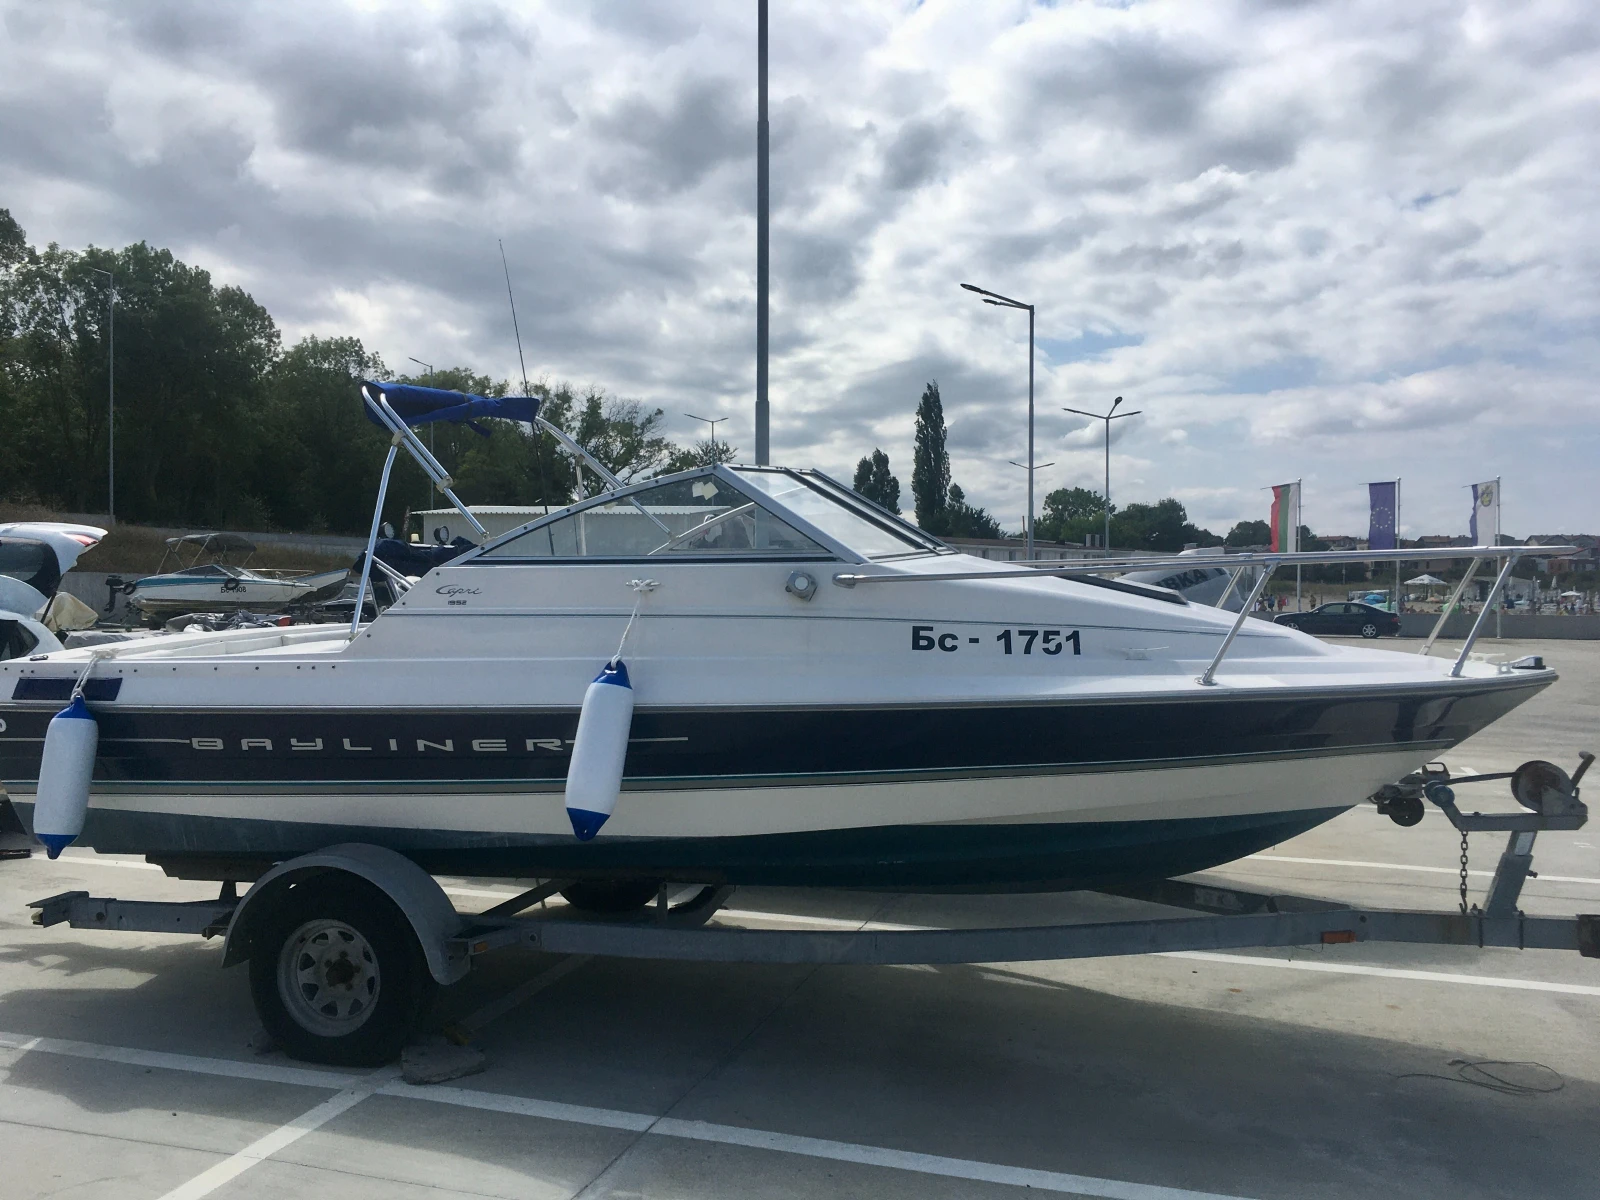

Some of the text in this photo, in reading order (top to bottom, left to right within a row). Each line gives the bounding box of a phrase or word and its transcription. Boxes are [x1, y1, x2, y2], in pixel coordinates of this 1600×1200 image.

[435, 584, 482, 597] Capri
[911, 625, 958, 652] Бс
[996, 629, 1081, 655] 1751
[191, 737, 564, 752] BAYLINER
